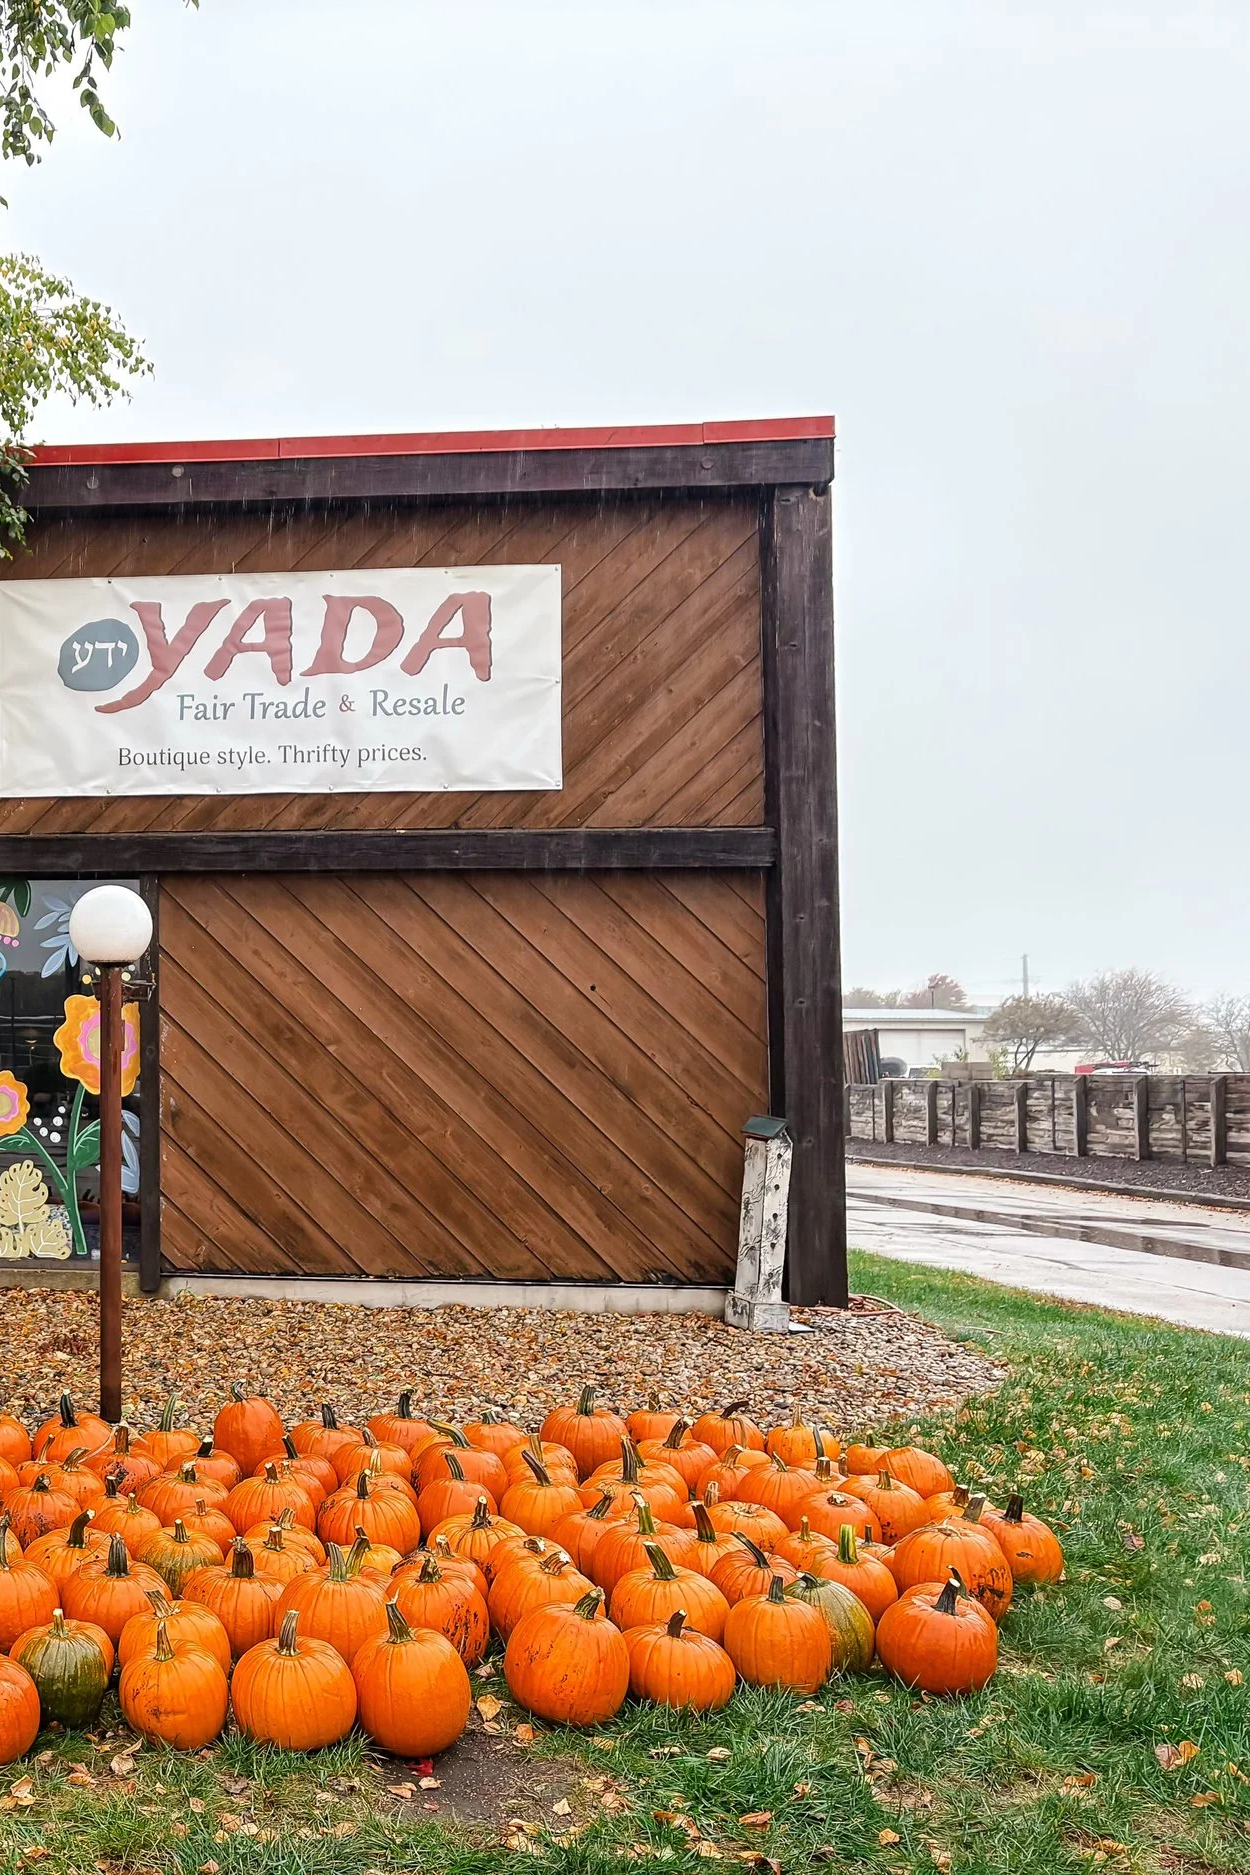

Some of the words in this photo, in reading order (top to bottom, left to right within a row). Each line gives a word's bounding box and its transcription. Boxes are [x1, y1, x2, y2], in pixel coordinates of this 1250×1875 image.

[71, 639, 128, 674] ידע
[95, 591, 492, 713] YADA
[176, 694, 236, 721] Fair
[242, 687, 327, 720] Trade
[338, 694, 356, 713] &
[369, 683, 466, 717] Resale
[118, 747, 211, 771] Boutique
[216, 746, 272, 770] style.
[278, 743, 351, 769] Thrifty
[357, 743, 428, 768] prices.
